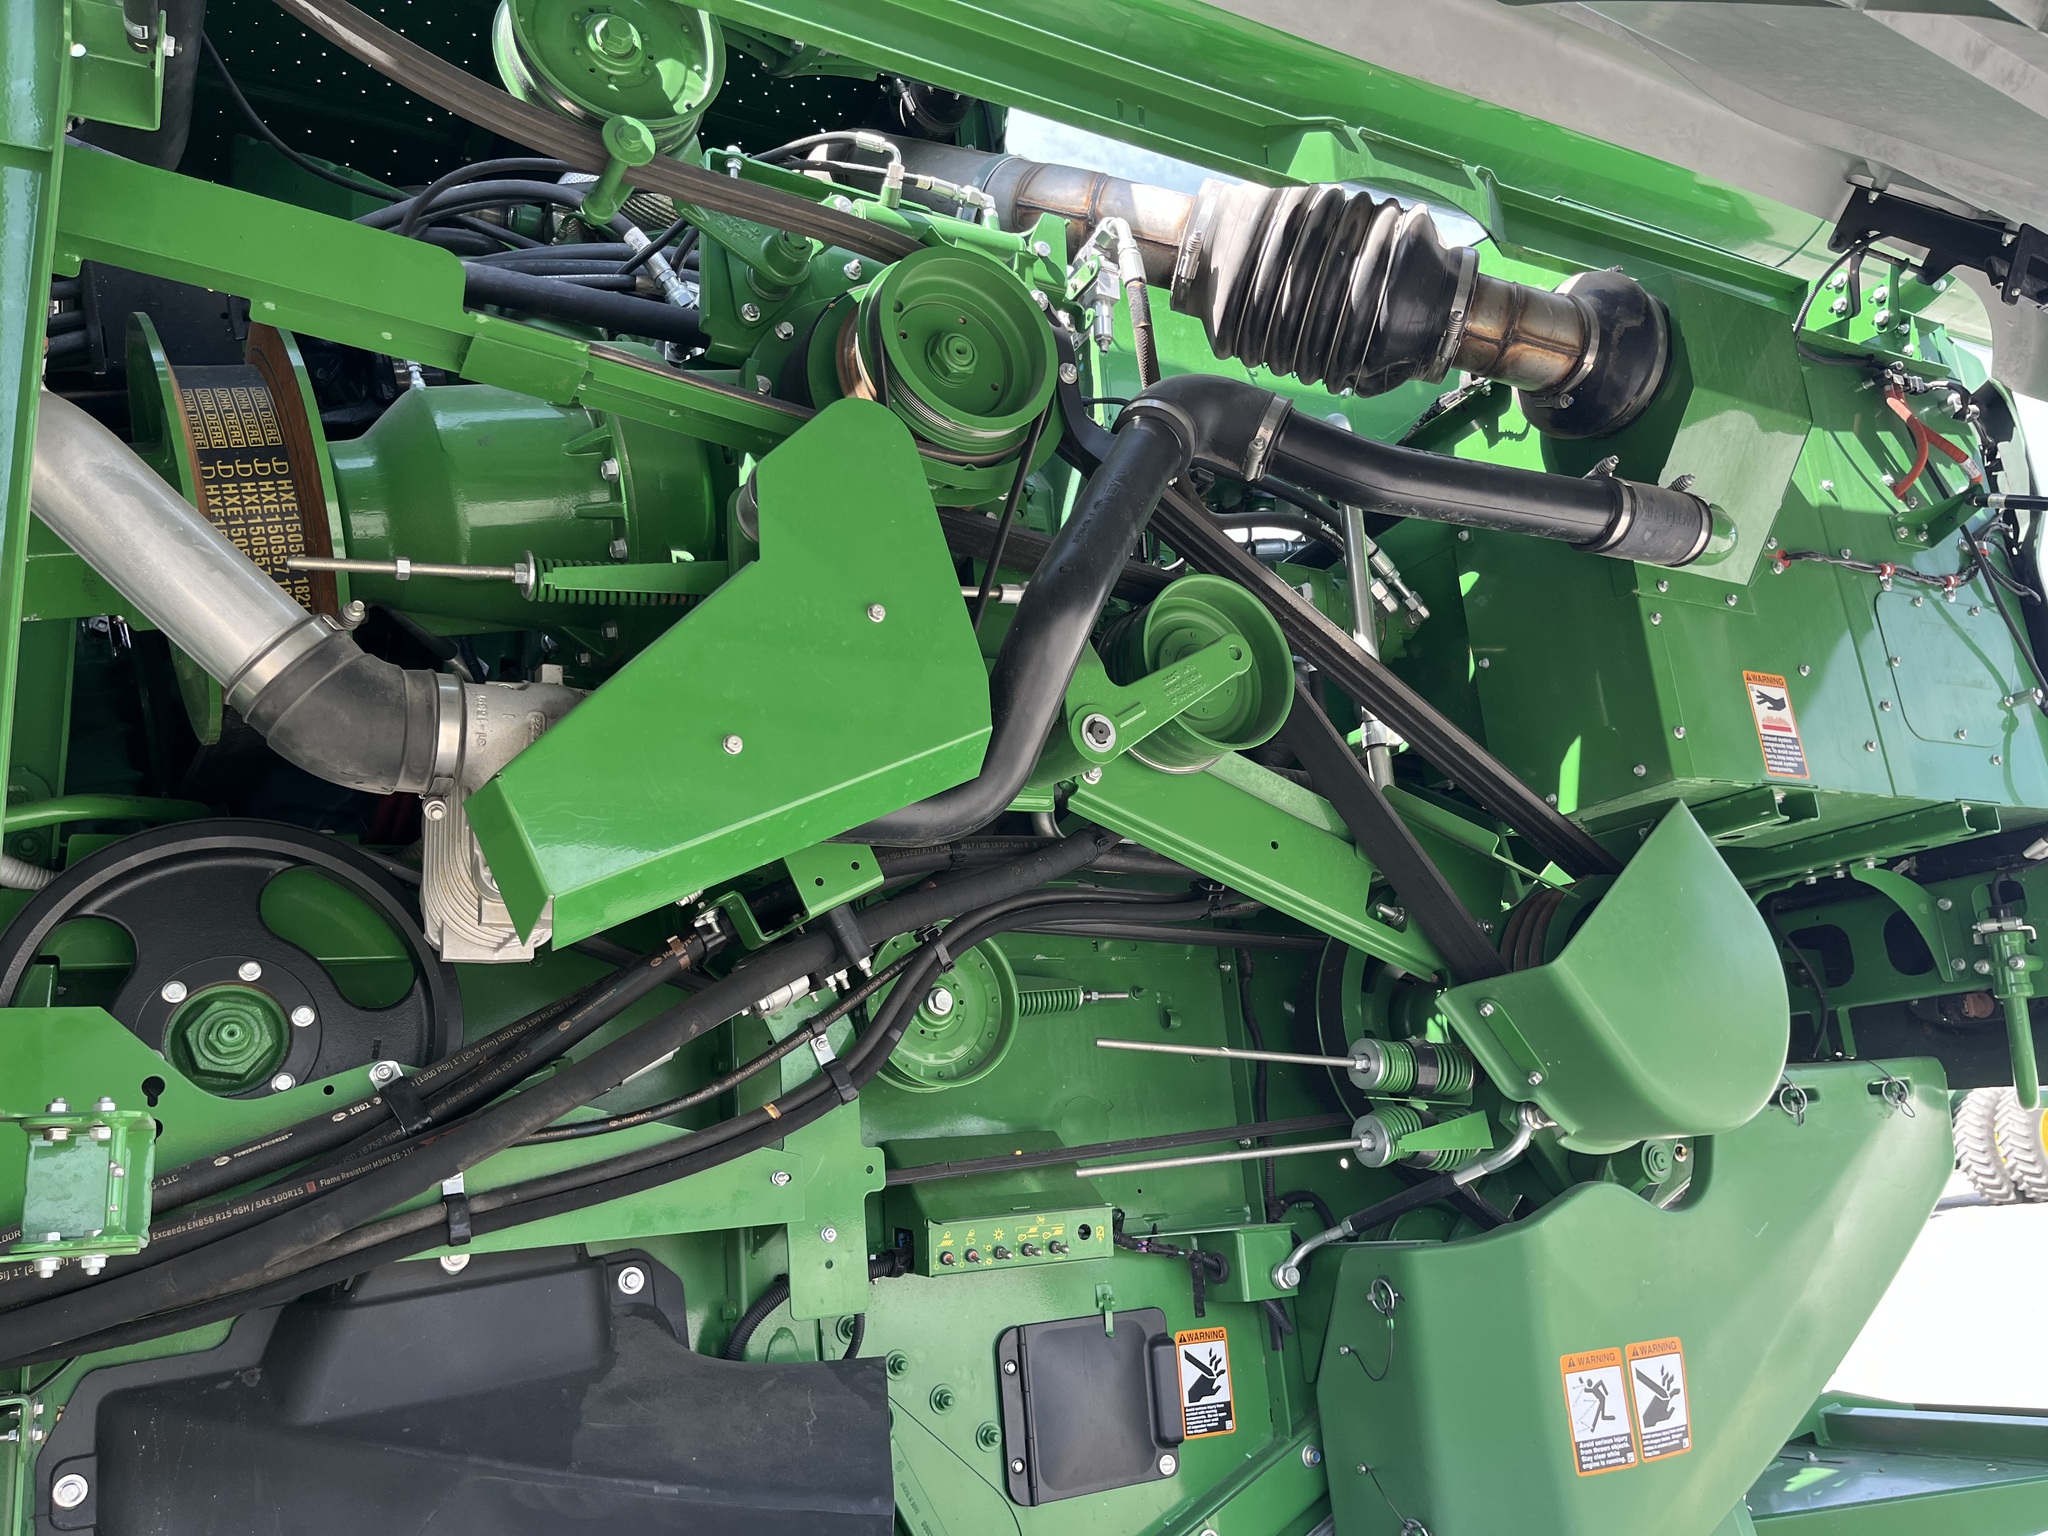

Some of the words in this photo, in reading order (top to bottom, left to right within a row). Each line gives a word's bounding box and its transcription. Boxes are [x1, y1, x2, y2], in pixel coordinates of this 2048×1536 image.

[188, 414, 206, 448] DEERE
[198, 389, 214, 411] JOHN
[206, 413, 224, 446] DEERE
[216, 388, 232, 410] JOHN
[224, 412, 243, 446] DEERE
[235, 388, 250, 410] JOHN
[243, 412, 261, 445] DEERE
[258, 481, 290, 574] HXE150557
[253, 387, 268, 408] JOHN
[262, 411, 280, 444] DEERE
[277, 480, 308, 572] HXE1505
[1752, 675, 1784, 686] WARNING
[447, 1083, 480, 1106] Resistant
[480, 1070, 501, 1086] MSHA
[152, 1225, 187, 1240] Exceeds
[233, 1204, 250, 1216] 4SH
[256, 1198, 271, 1209] SAE
[272, 1187, 304, 1204] 100R15
[320, 1176, 341, 1187] Flame
[341, 1163, 373, 1179] Resistant
[373, 1156, 391, 1168] MSHA
[1186, 1330, 1225, 1341] WARNING
[1640, 1341, 1677, 1355] WARNING
[1577, 1352, 1616, 1366] WARNING
